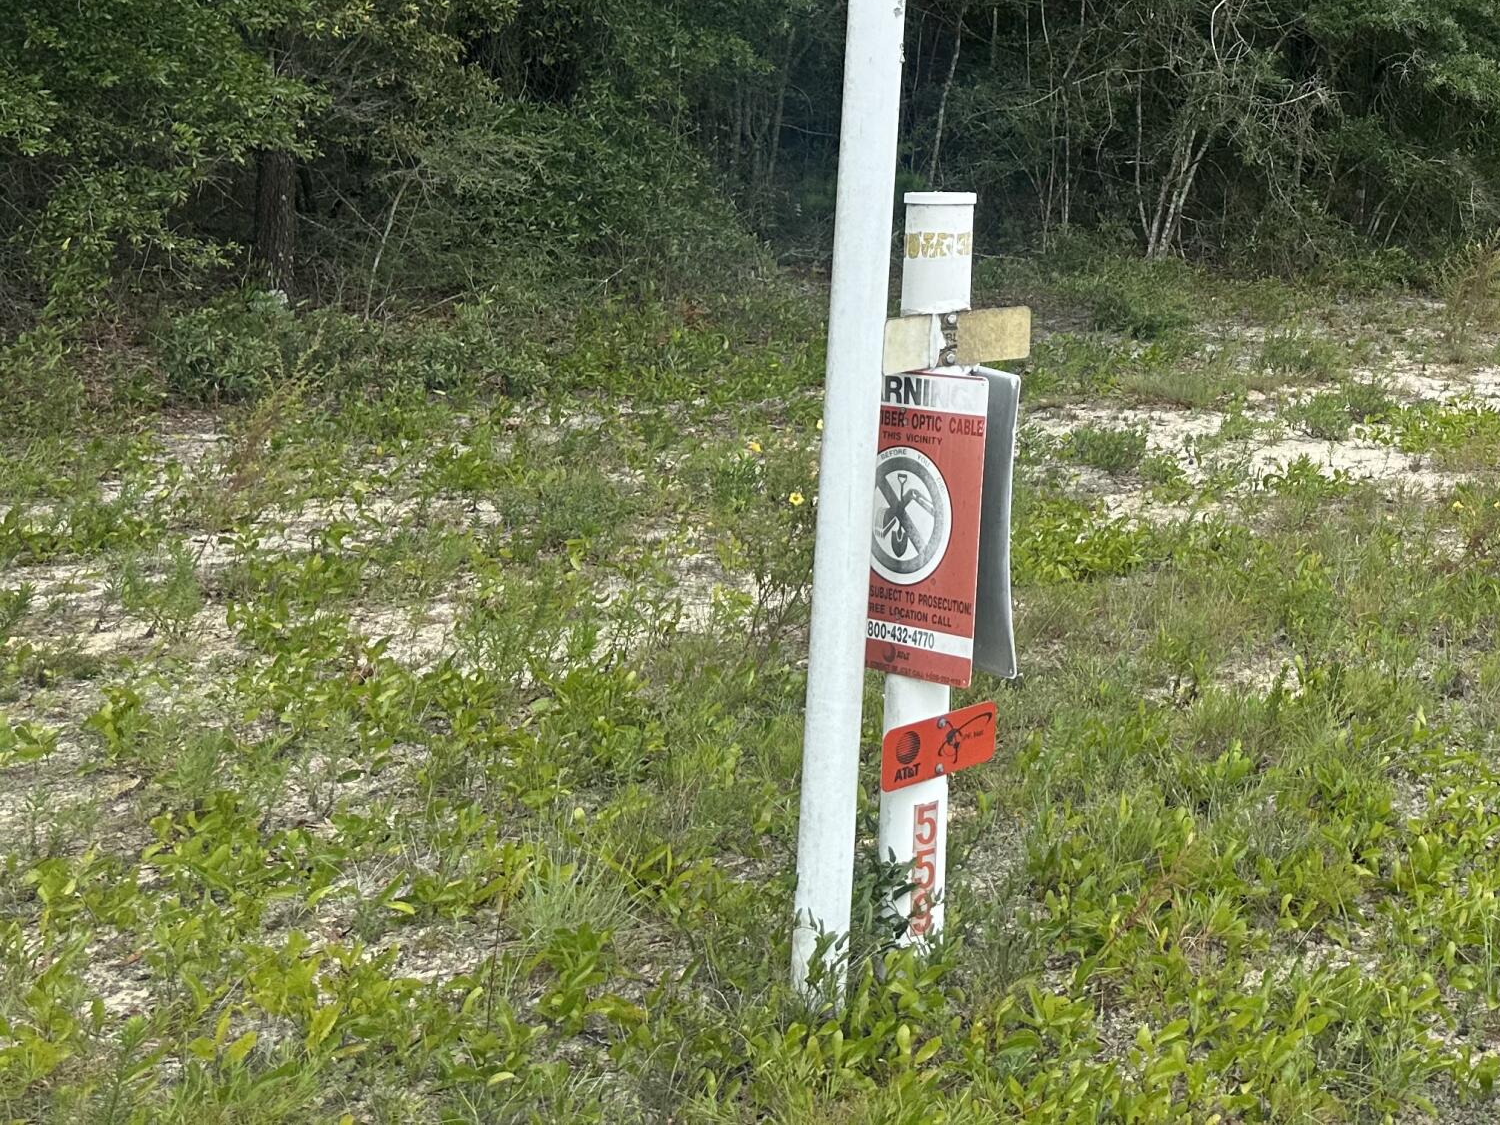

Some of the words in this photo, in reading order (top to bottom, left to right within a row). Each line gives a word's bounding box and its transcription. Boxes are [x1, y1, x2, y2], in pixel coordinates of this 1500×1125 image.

[880, 409, 905, 428] IBER
[911, 413, 942, 433] OPTIC
[949, 416, 984, 437] CABLE
[882, 430, 902, 441] THIS
[906, 433, 943, 446] VICINITY
[869, 585, 902, 602] SUBJECT
[905, 591, 915, 606] TO
[868, 602, 886, 614] REE
[889, 606, 928, 623] LOCATION
[931, 614, 952, 628] CALL
[894, 762, 921, 783] AT&T
